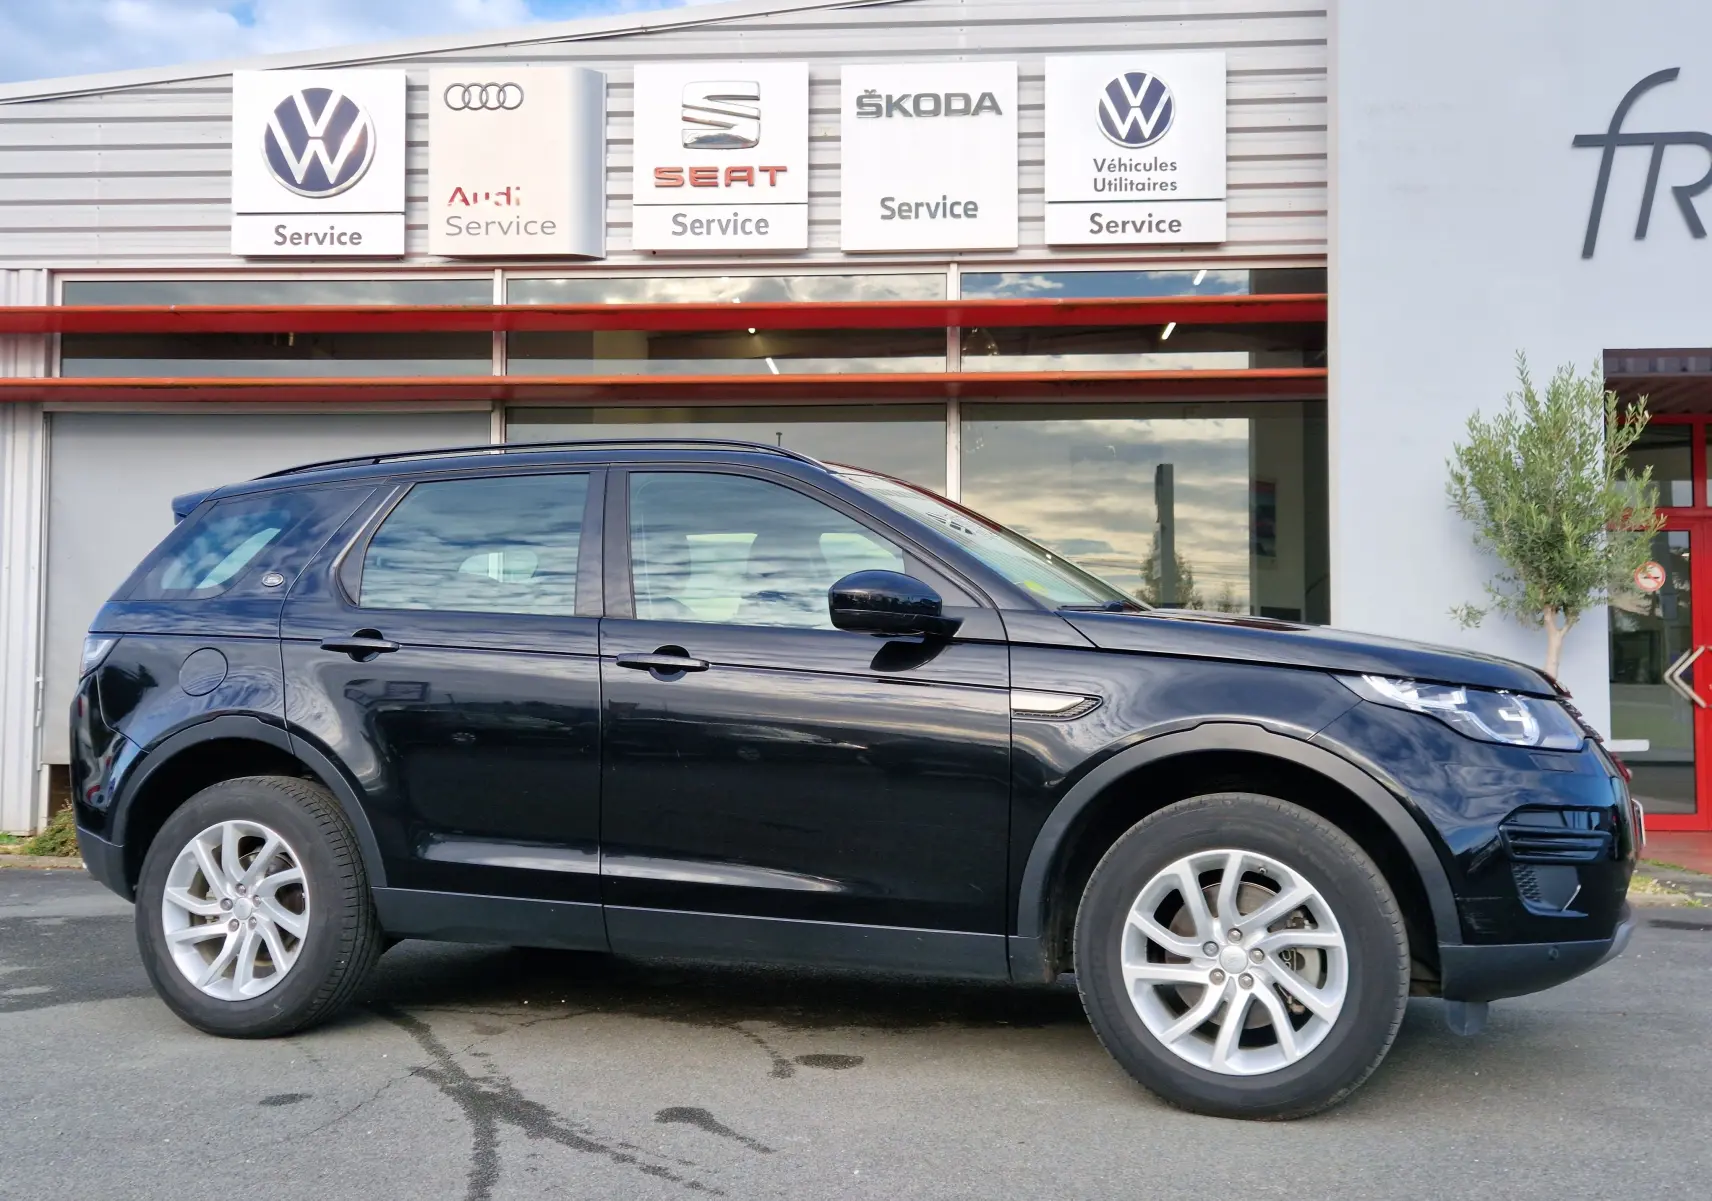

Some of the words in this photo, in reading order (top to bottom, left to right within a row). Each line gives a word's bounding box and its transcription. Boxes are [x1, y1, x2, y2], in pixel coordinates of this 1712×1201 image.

[856, 89, 1003, 119] ŠKODA
[1092, 156, 1178, 173] Véhicules
[653, 165, 788, 188] SEAT
[1092, 177, 1178, 193] Utilitaires
[880, 195, 979, 221] Service
[445, 215, 557, 237] Service
[671, 212, 770, 237] Service
[1088, 212, 1183, 235] Service
[273, 224, 363, 247] Service
